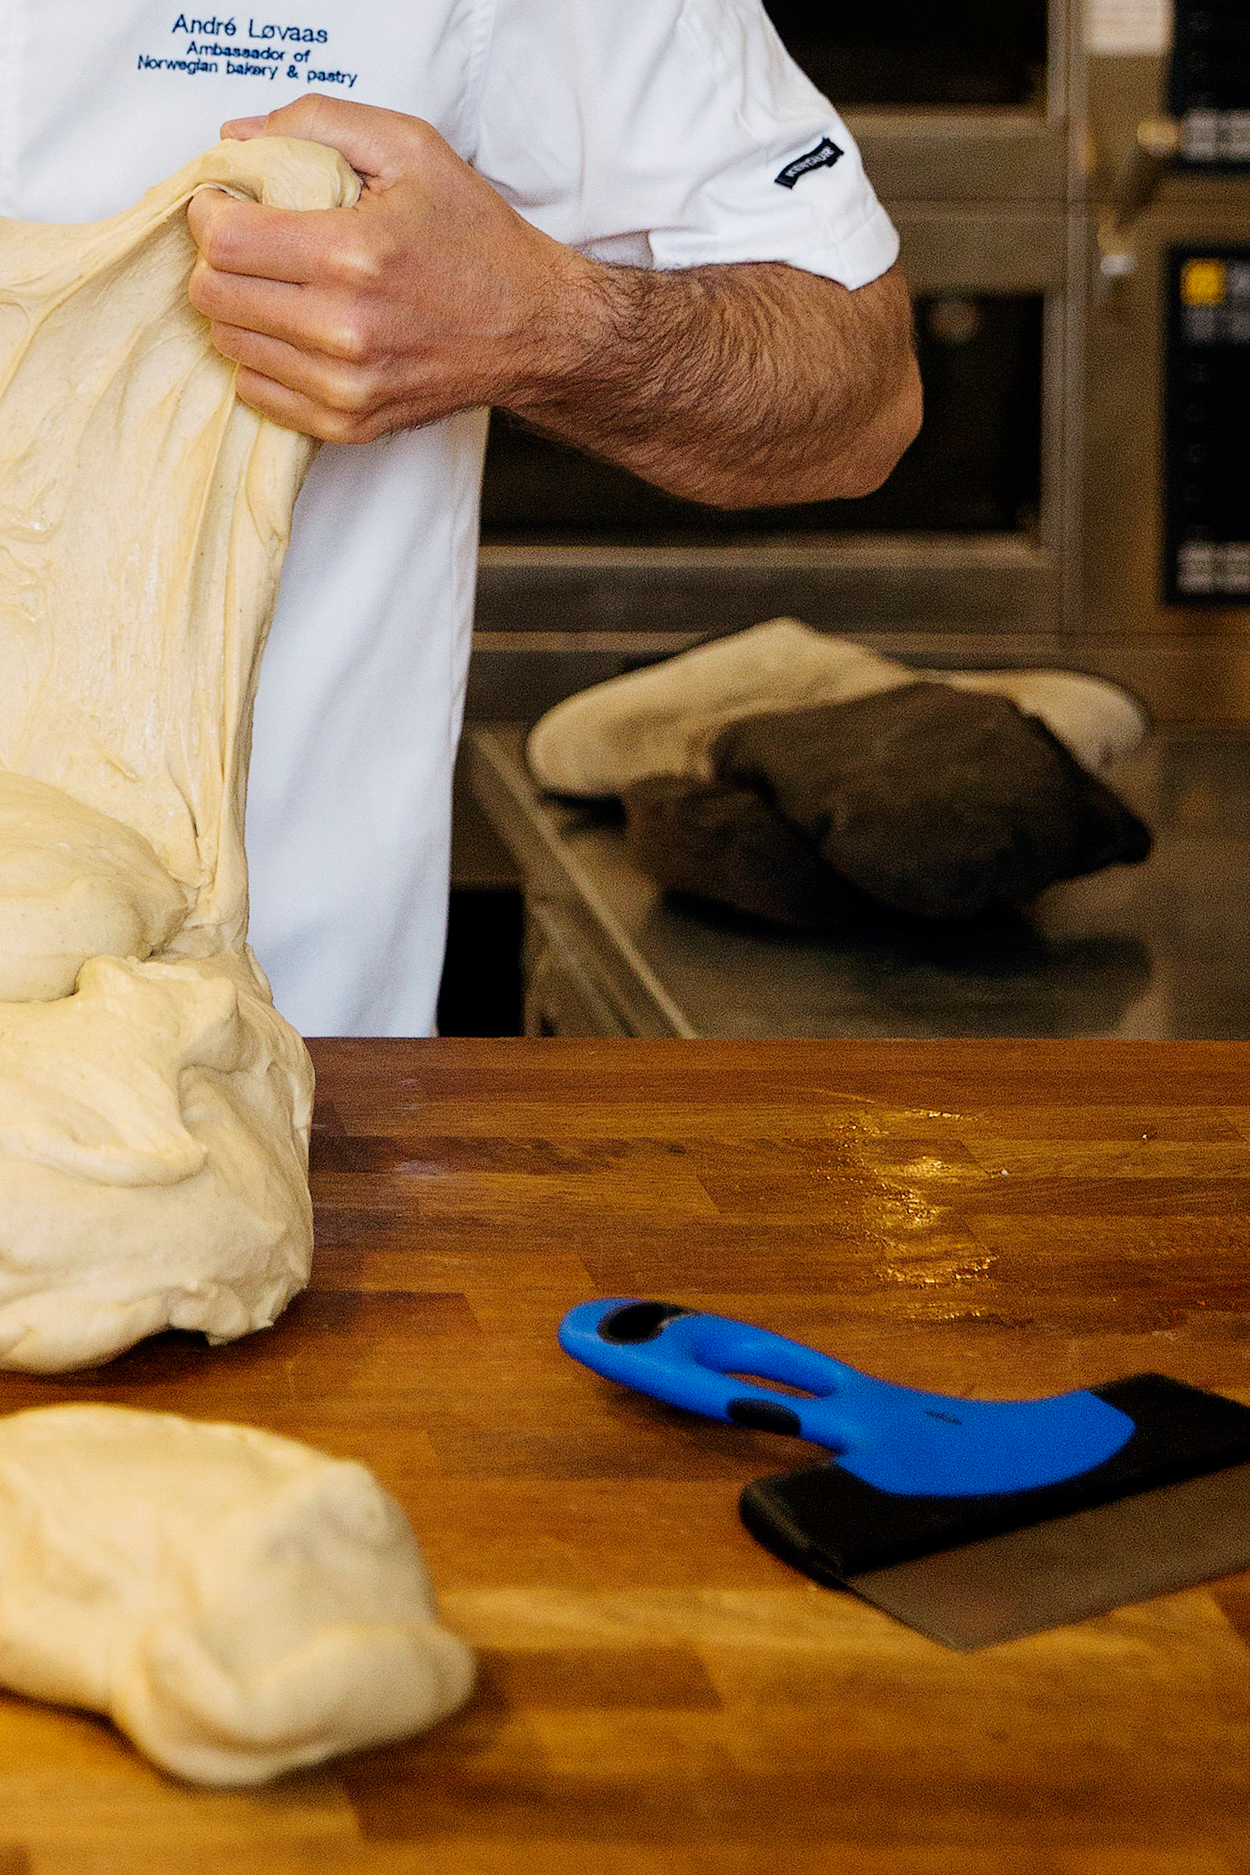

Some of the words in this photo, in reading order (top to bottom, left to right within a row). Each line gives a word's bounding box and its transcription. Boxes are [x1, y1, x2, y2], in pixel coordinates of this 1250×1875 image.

[171, 13, 237, 37] André
[249, 18, 328, 44] Løvaas
[186, 41, 285, 62] Ambassador
[293, 49, 311, 63] of
[137, 55, 218, 75] Norwegian
[226, 60, 278, 80] bakery
[286, 64, 299, 79] &
[306, 69, 358, 88] pastry
